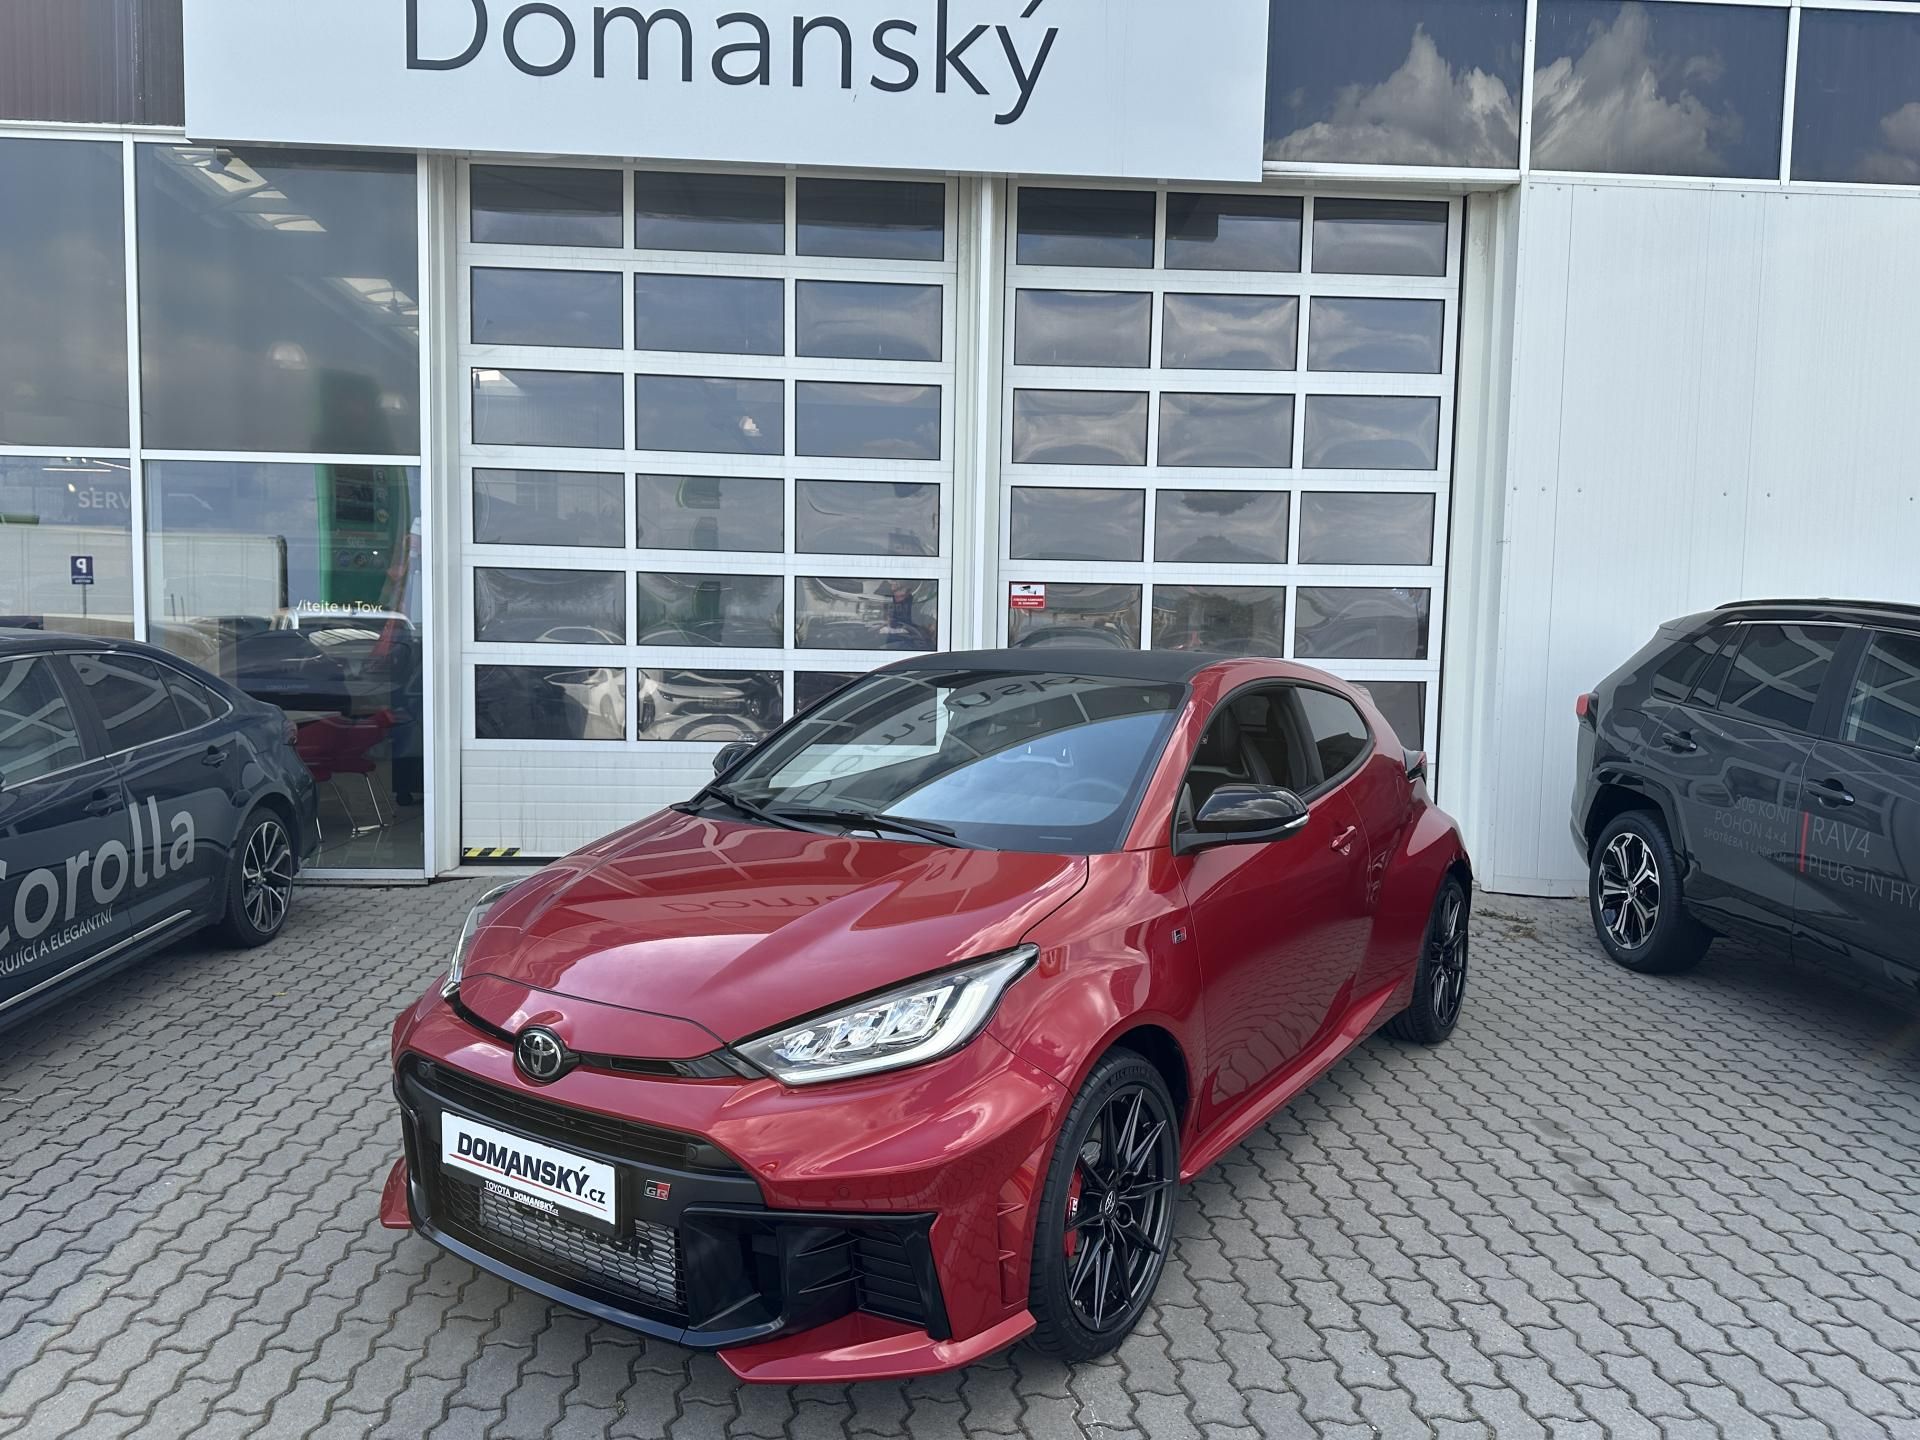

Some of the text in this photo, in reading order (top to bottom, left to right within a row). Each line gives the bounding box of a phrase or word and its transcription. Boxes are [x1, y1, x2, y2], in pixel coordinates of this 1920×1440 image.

[405, 0, 1059, 125] Domanský
[342, 604, 351, 612] u
[1713, 810, 1763, 839] POHON
[1811, 816, 1870, 859] RAV4
[1808, 853, 1920, 912] PLUG-IN HY
[40, 940, 50, 957] A
[50, 904, 113, 951] ELEGANTNÍ
[484, 1180, 511, 1198] TOYOTA
[645, 1184, 669, 1200] GR
